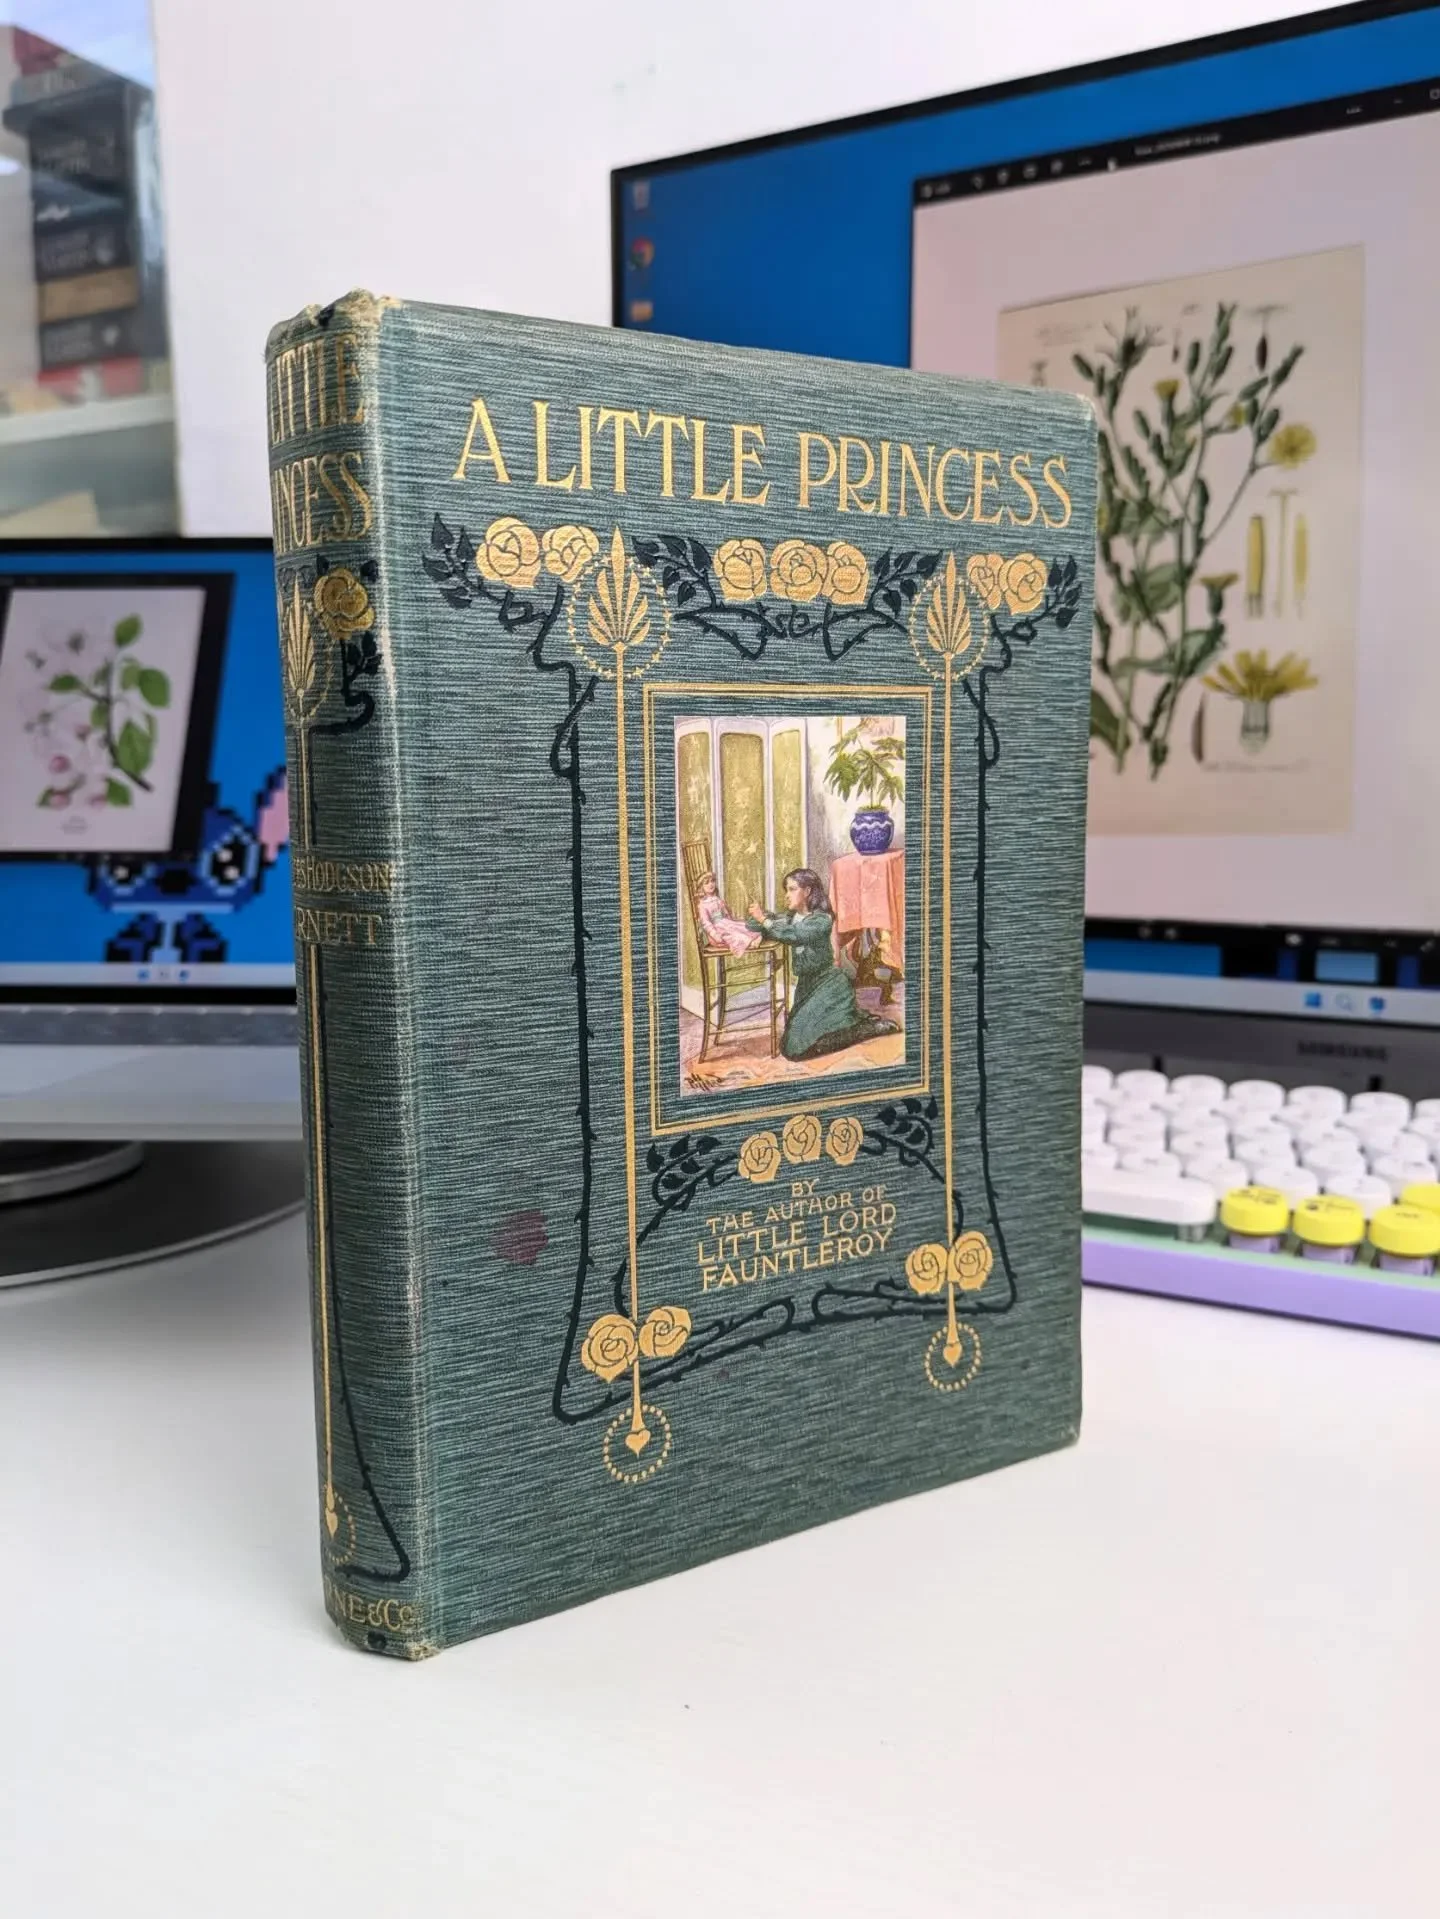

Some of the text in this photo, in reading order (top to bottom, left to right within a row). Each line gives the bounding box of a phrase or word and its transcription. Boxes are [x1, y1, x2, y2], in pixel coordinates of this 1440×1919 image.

[452, 396, 1072, 529] A LITTLE PRINCESS
[273, 451, 373, 556] INCESS
[294, 906, 384, 946] RNETT
[706, 1184, 887, 1235] THE AUTHOR OF
[791, 1178, 820, 1197] BY
[697, 1202, 897, 1265] LITTLE LORD
[701, 1226, 894, 1292] FAUNTLEROY
